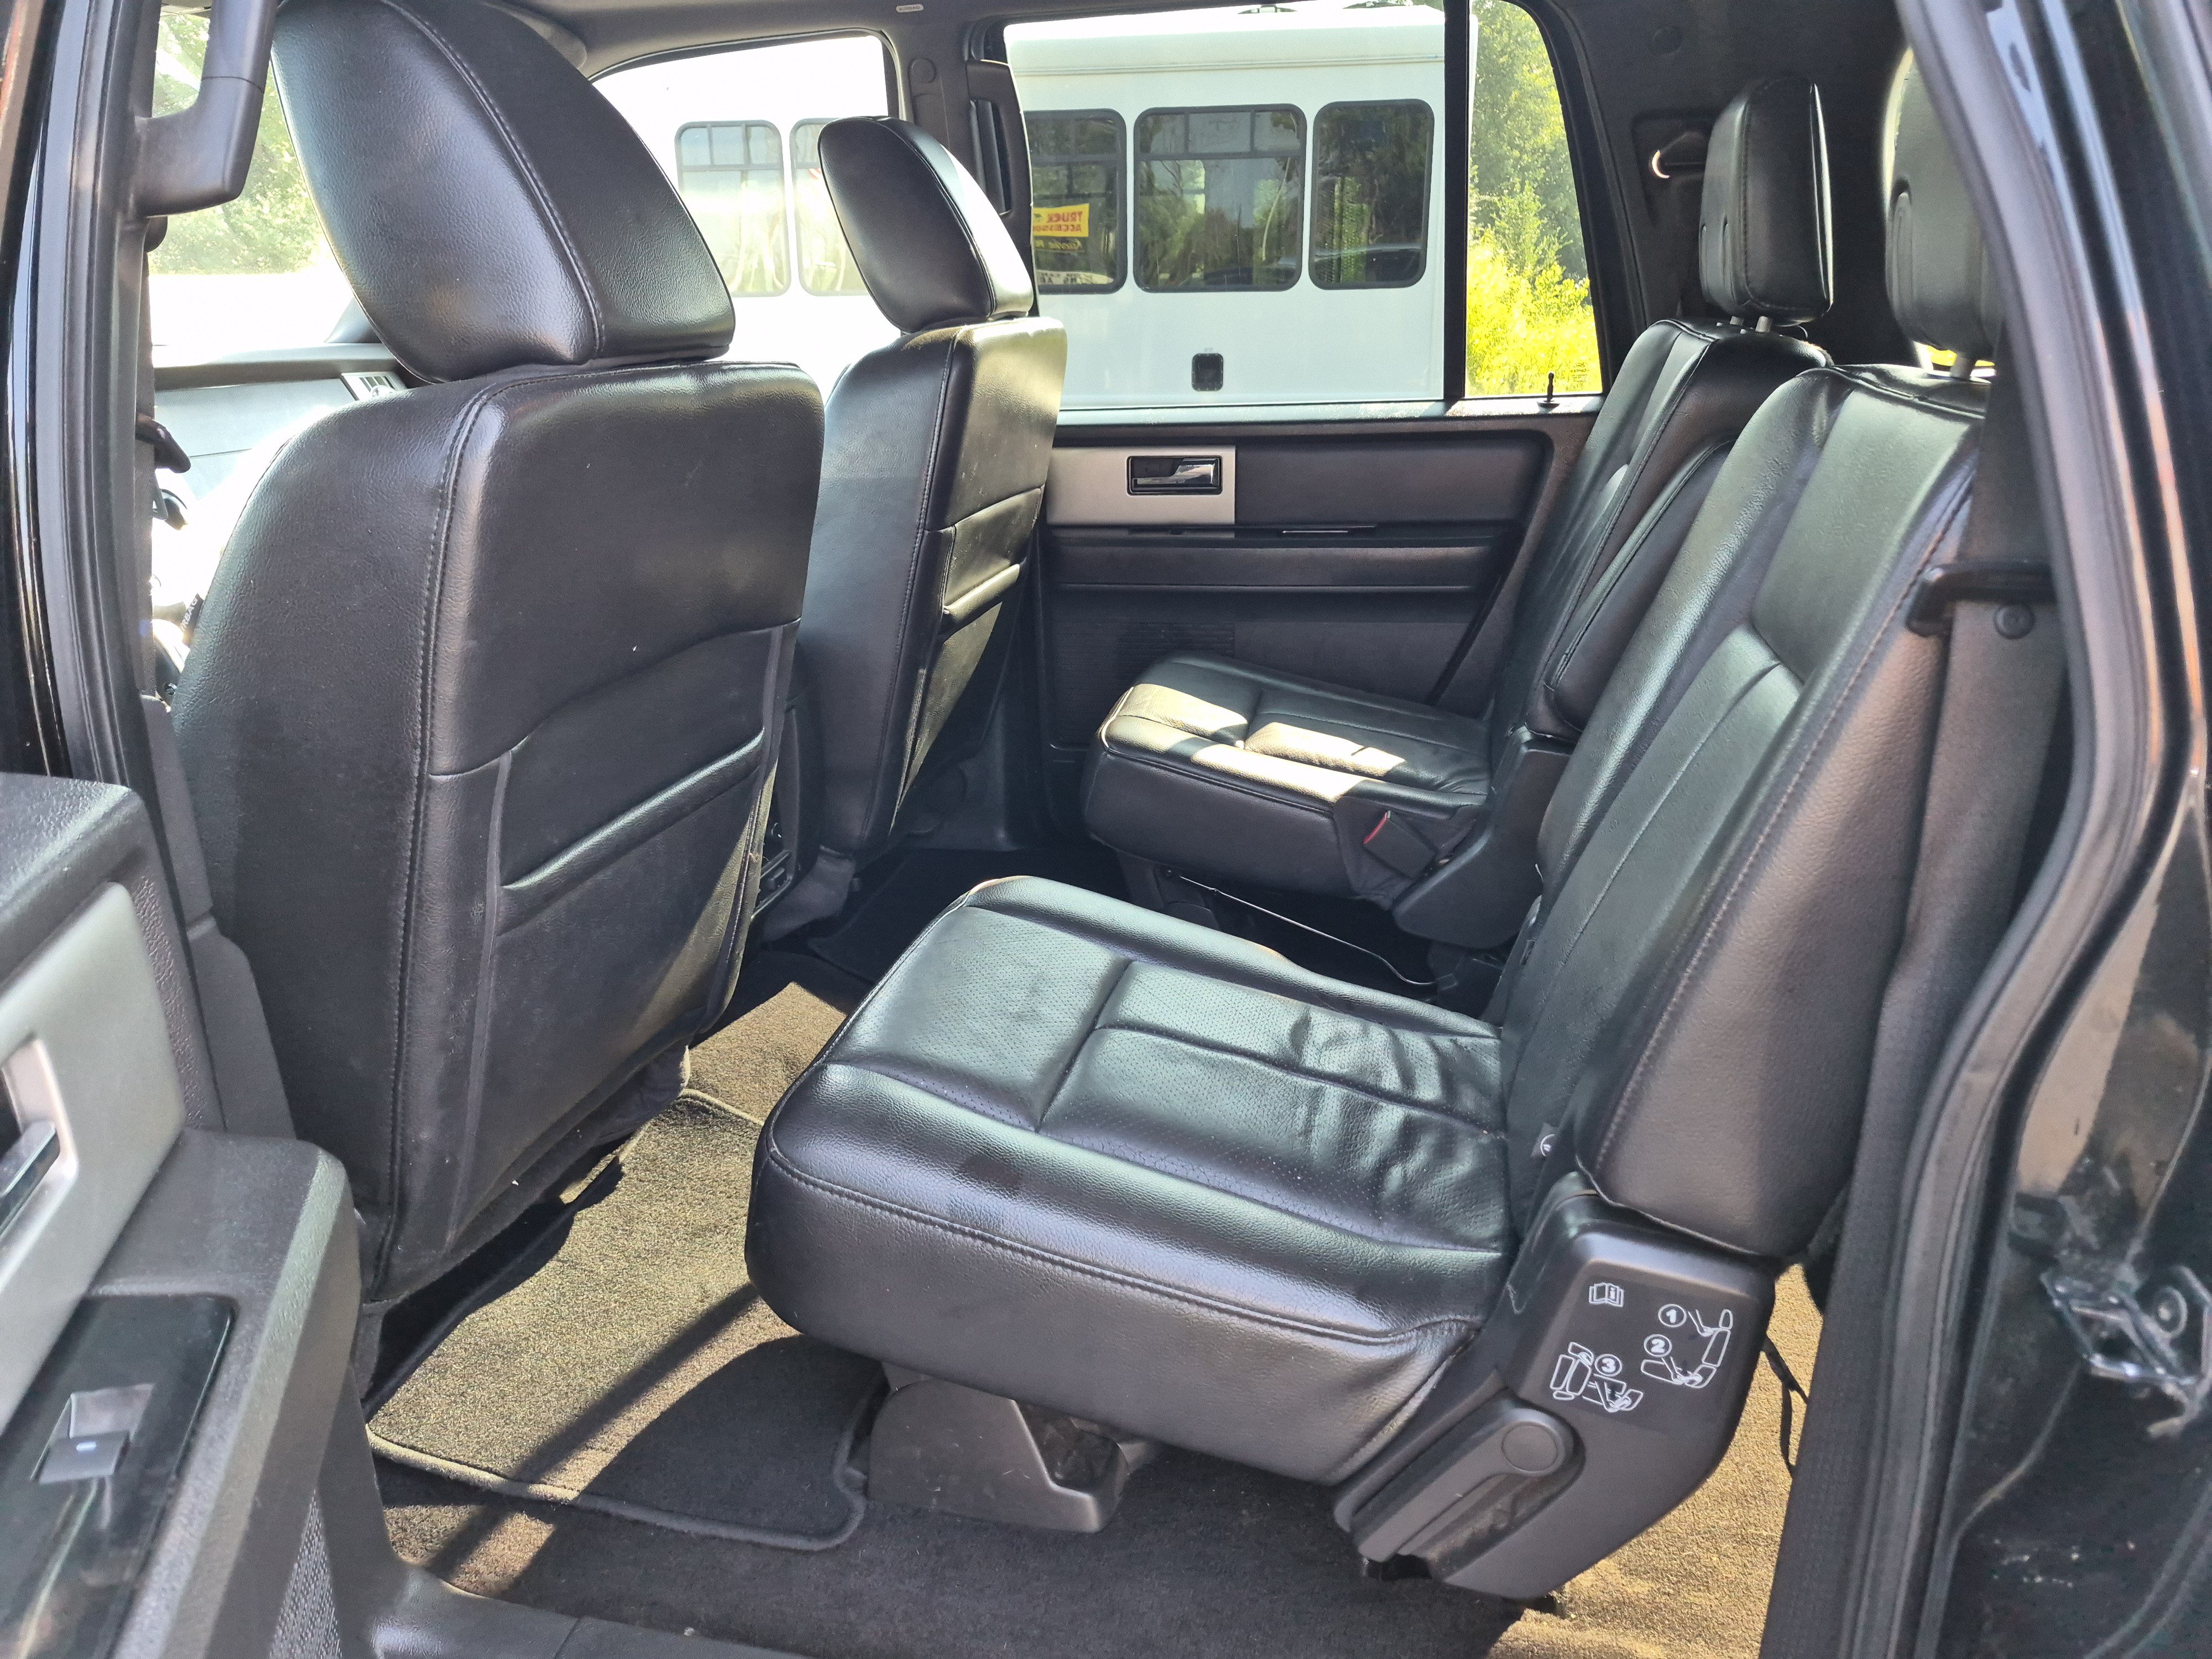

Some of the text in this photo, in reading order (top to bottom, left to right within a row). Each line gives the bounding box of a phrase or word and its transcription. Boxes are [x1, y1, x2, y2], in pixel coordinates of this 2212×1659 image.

[1666, 1309, 1677, 1323] 1
[1651, 1338, 1665, 1353] 2
[1601, 1358, 1616, 1373] 3
